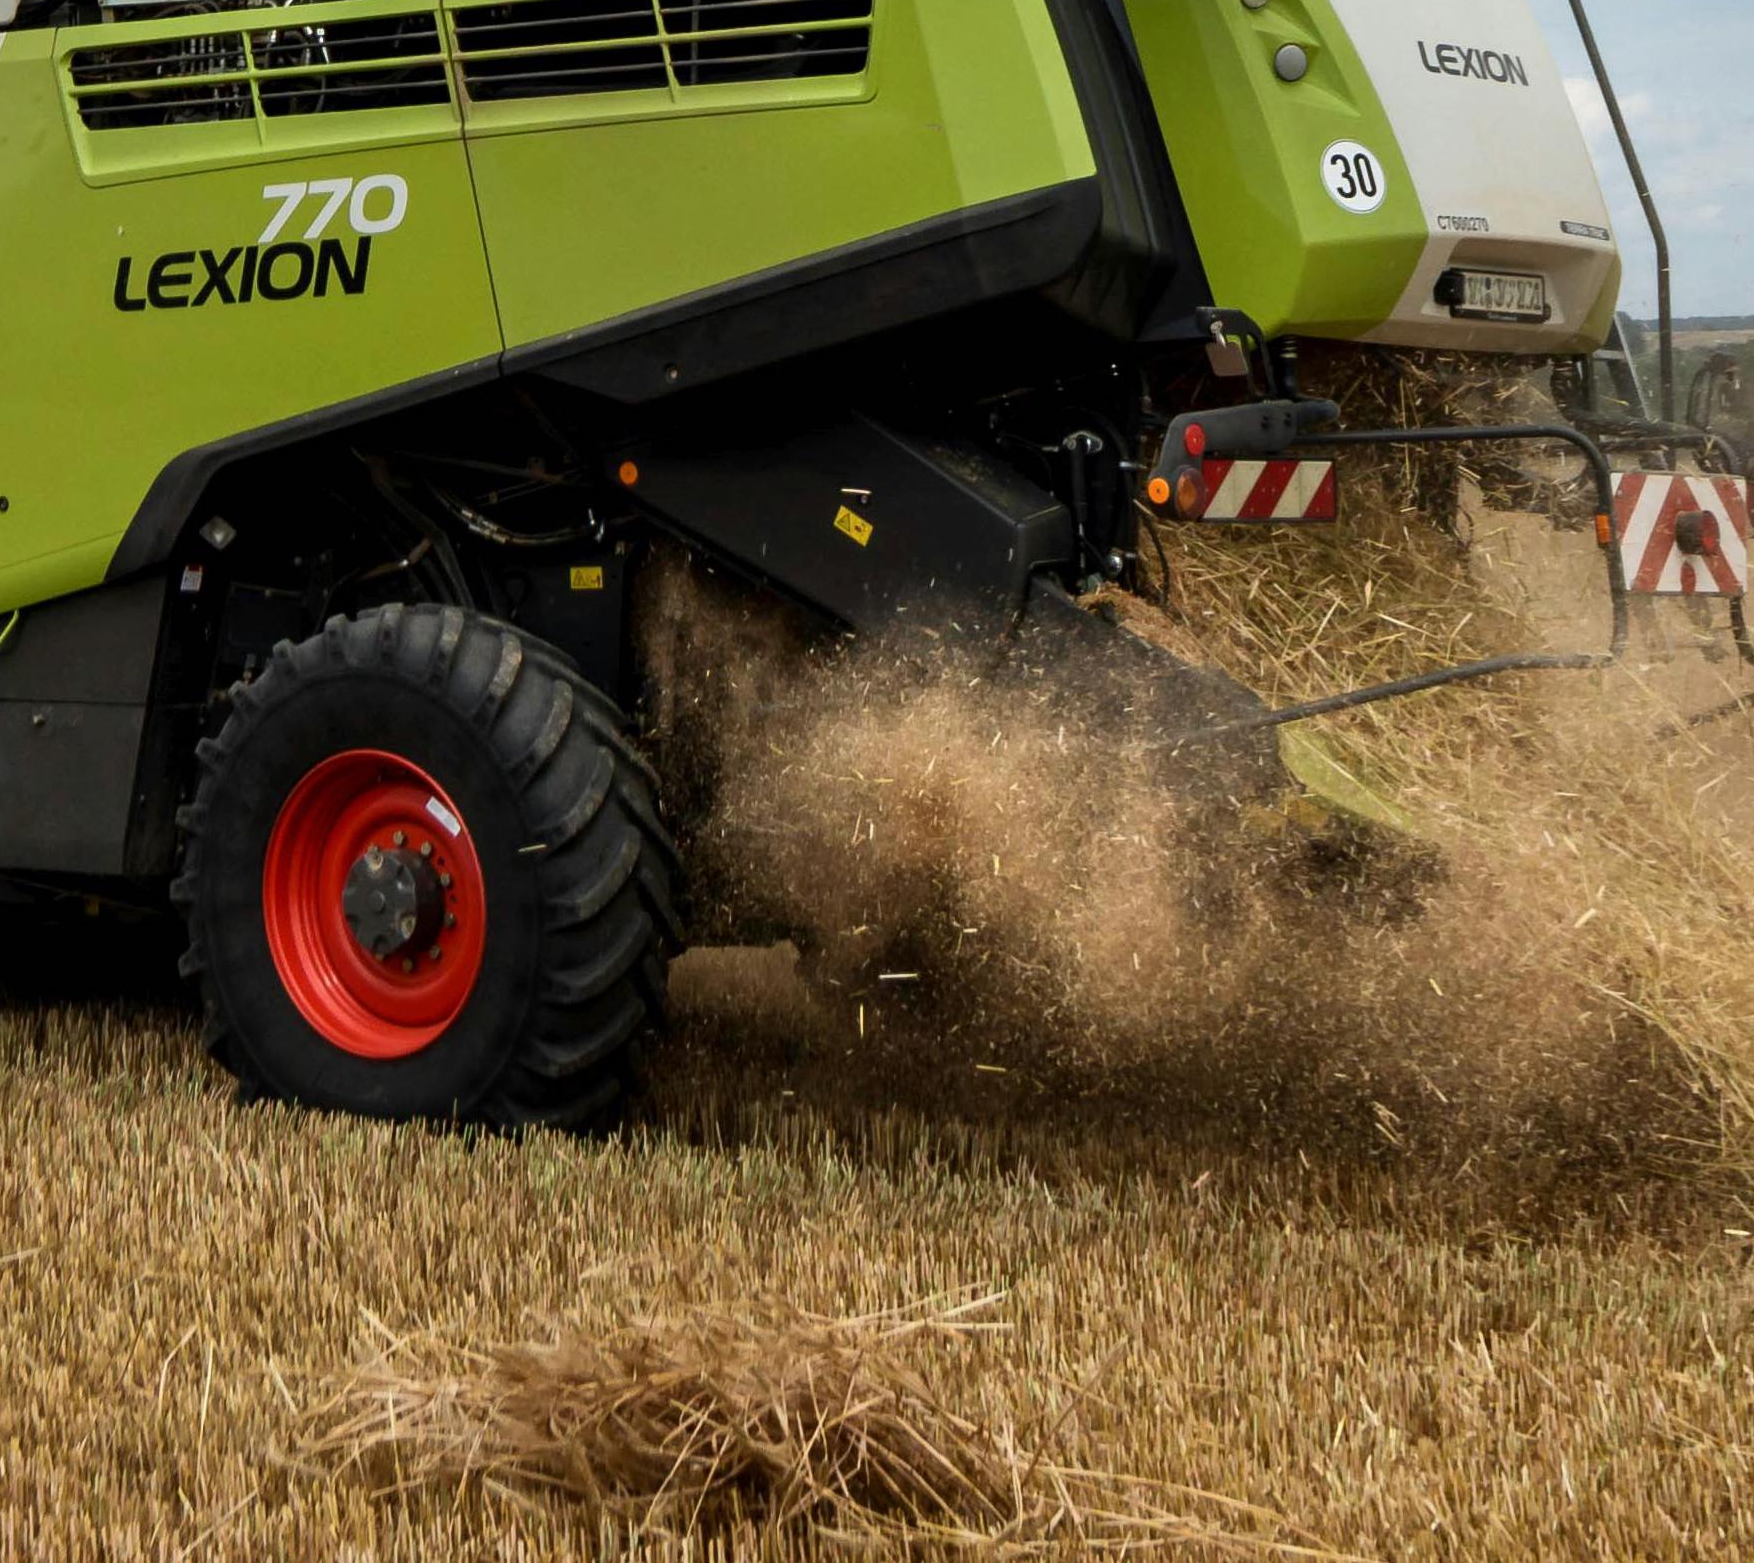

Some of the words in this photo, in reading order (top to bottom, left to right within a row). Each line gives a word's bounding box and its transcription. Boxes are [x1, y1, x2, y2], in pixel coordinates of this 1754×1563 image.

[1417, 40, 1530, 87] LEXION
[1330, 153, 1377, 199] 30
[257, 174, 408, 244] 770
[113, 235, 372, 312] LEXION
